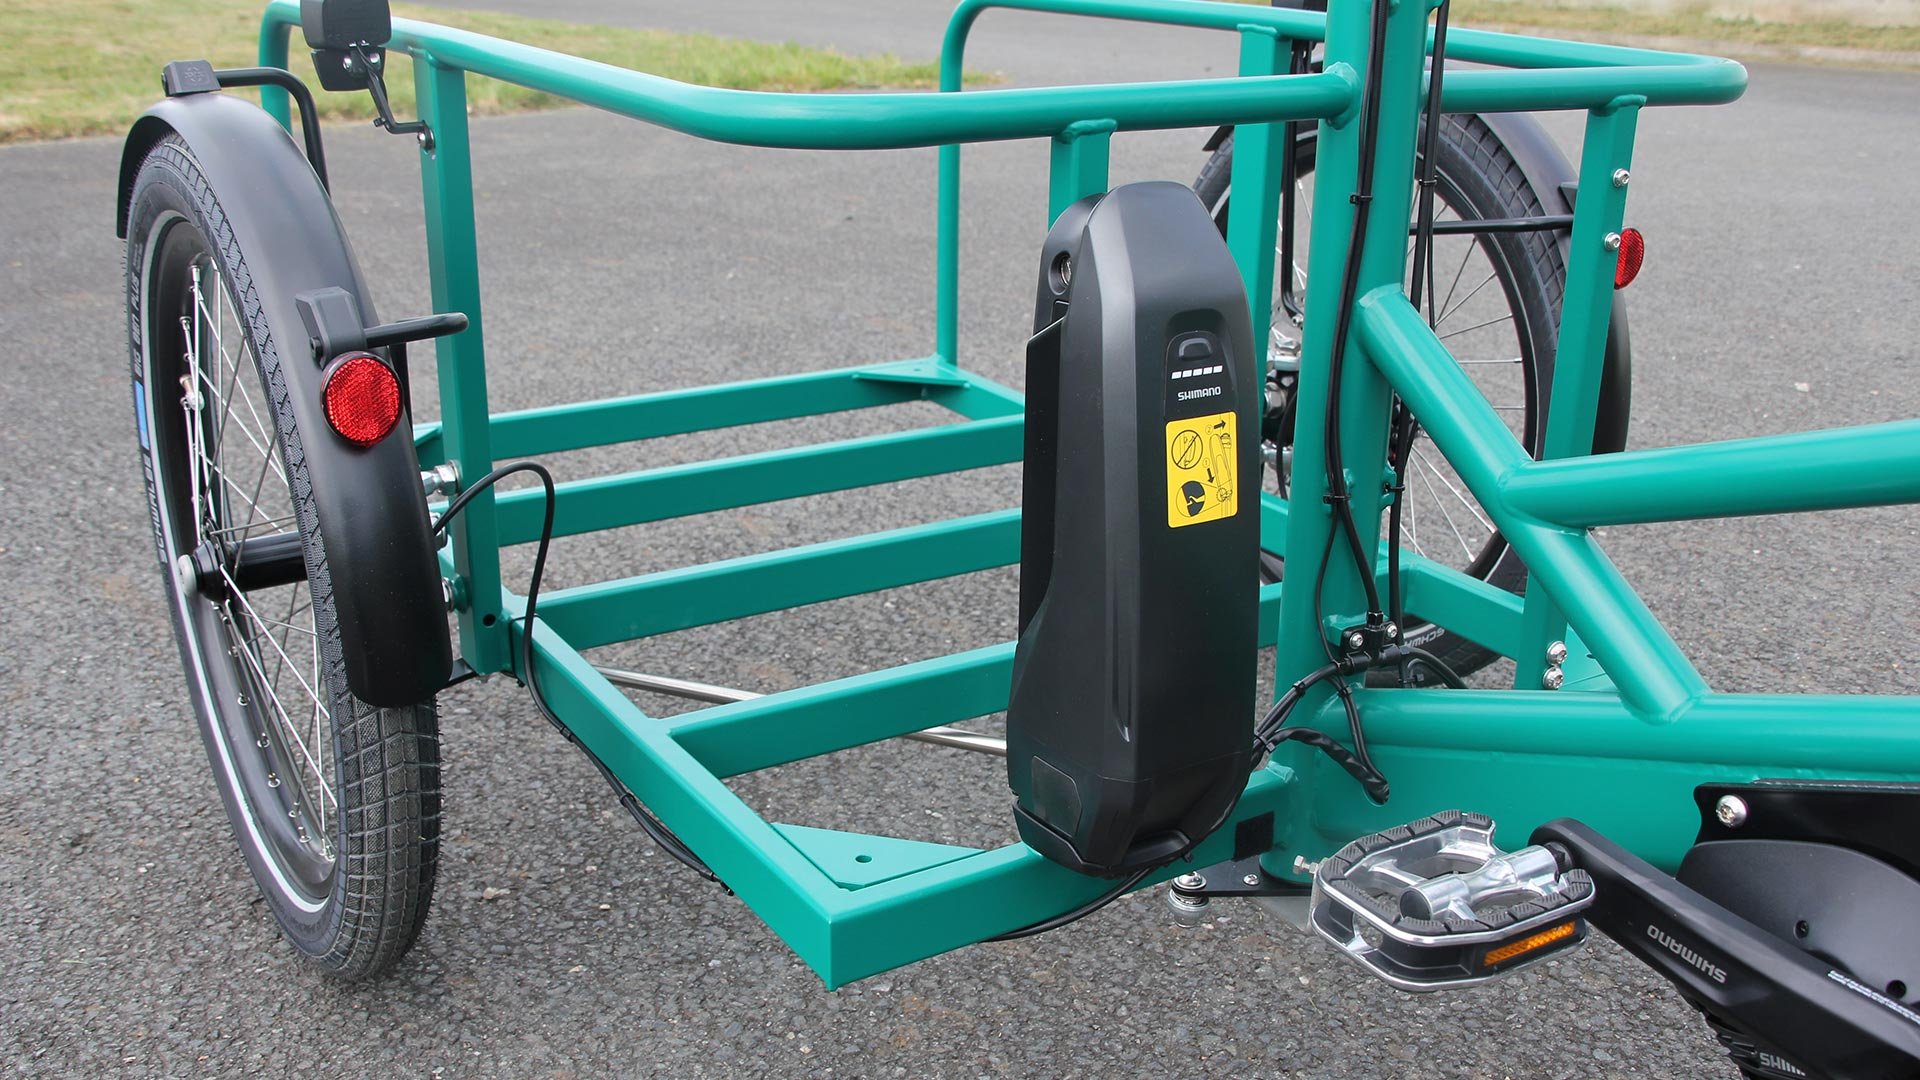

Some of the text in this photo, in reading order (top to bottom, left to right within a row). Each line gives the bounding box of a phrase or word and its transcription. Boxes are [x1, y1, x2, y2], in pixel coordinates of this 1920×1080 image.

[130, 271, 141, 311] PLUS
[132, 348, 143, 378] BIG
[1177, 386, 1222, 401] SHIMANO
[142, 453, 168, 563] SCHWALBE
[1646, 924, 1728, 984] SHIMANO
